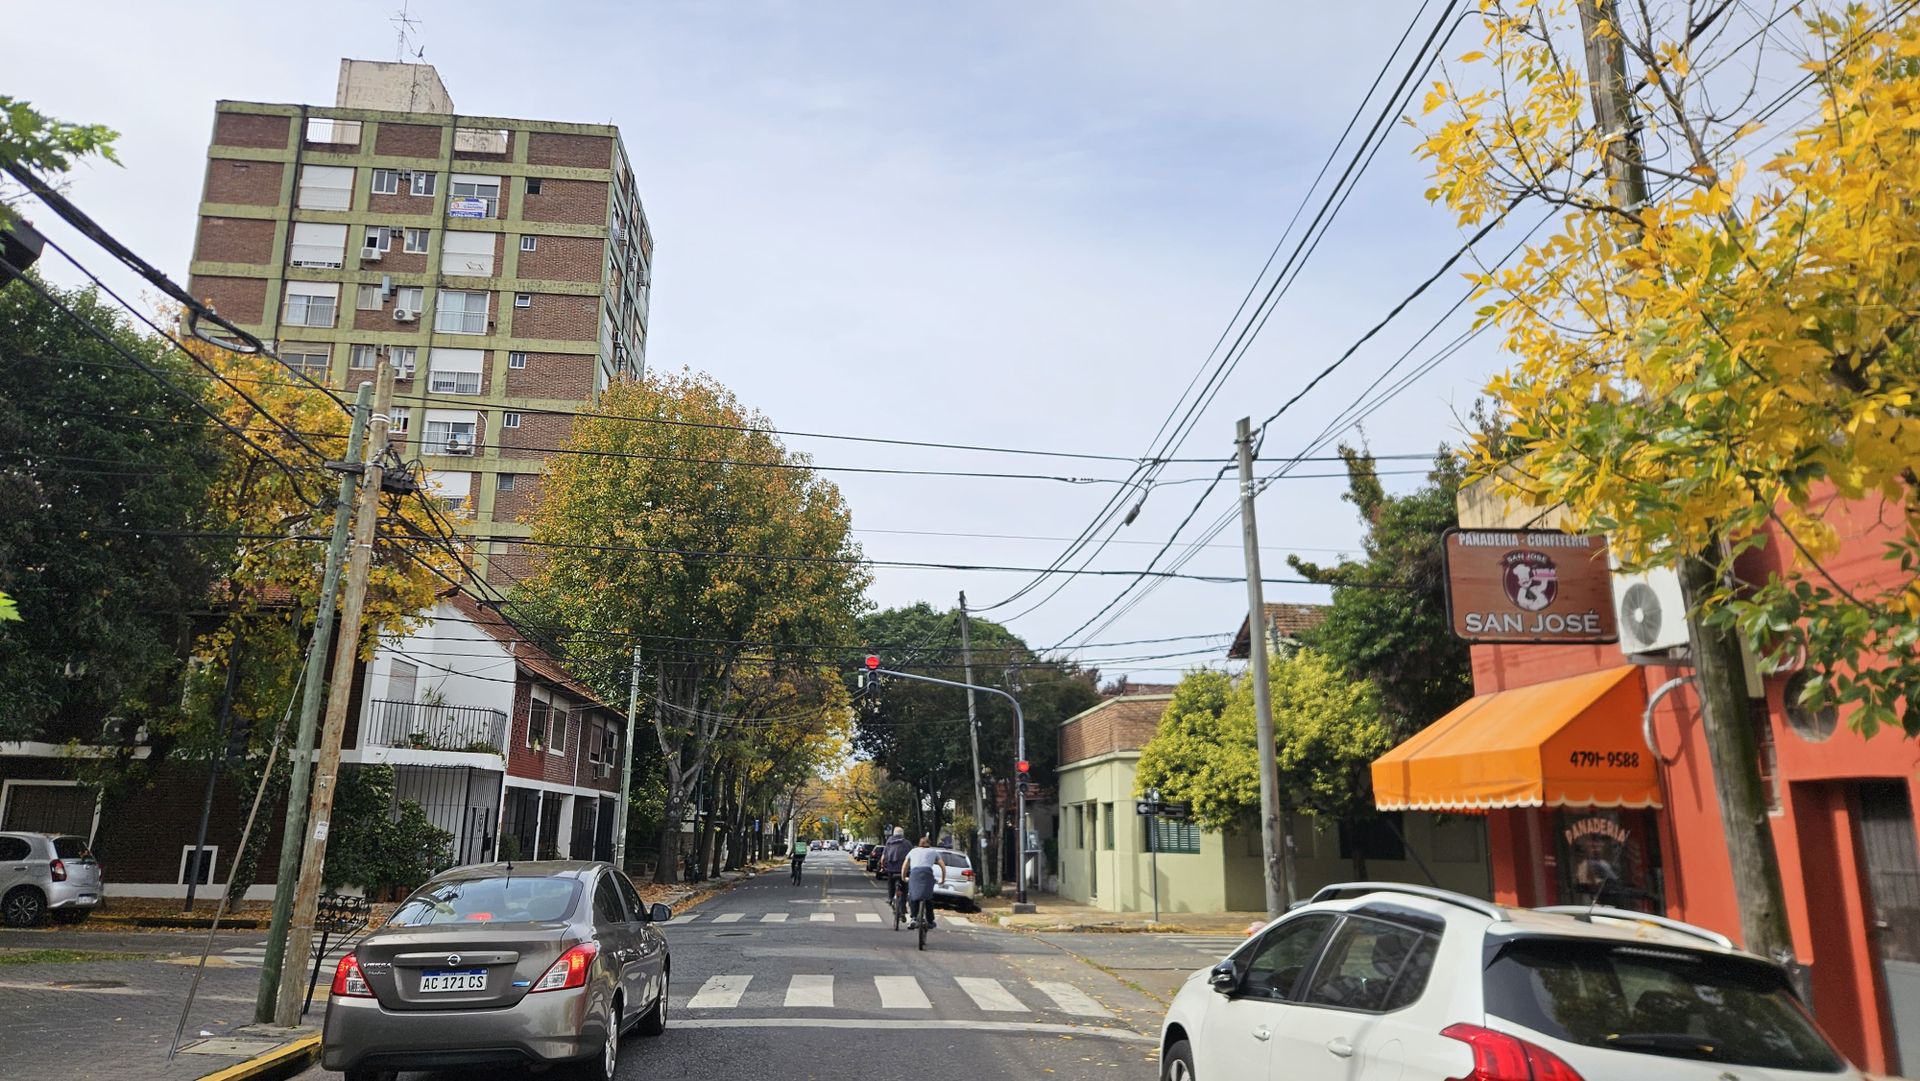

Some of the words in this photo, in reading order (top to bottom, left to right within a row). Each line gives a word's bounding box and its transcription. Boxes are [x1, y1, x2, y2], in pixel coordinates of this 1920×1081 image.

[1458, 532, 1519, 547] PANADERIA
[1526, 533, 1590, 547] CONFITERIA
[1507, 552, 1525, 563] SAN
[1465, 612, 1523, 633] SAN
[1530, 608, 1602, 633] JOSÉ
[1569, 750, 1640, 768] 4791-9588
[1564, 817, 1627, 845] PANADERIA
[423, 977, 439, 990] AC
[441, 976, 464, 990] 171
[468, 975, 484, 988] CS
